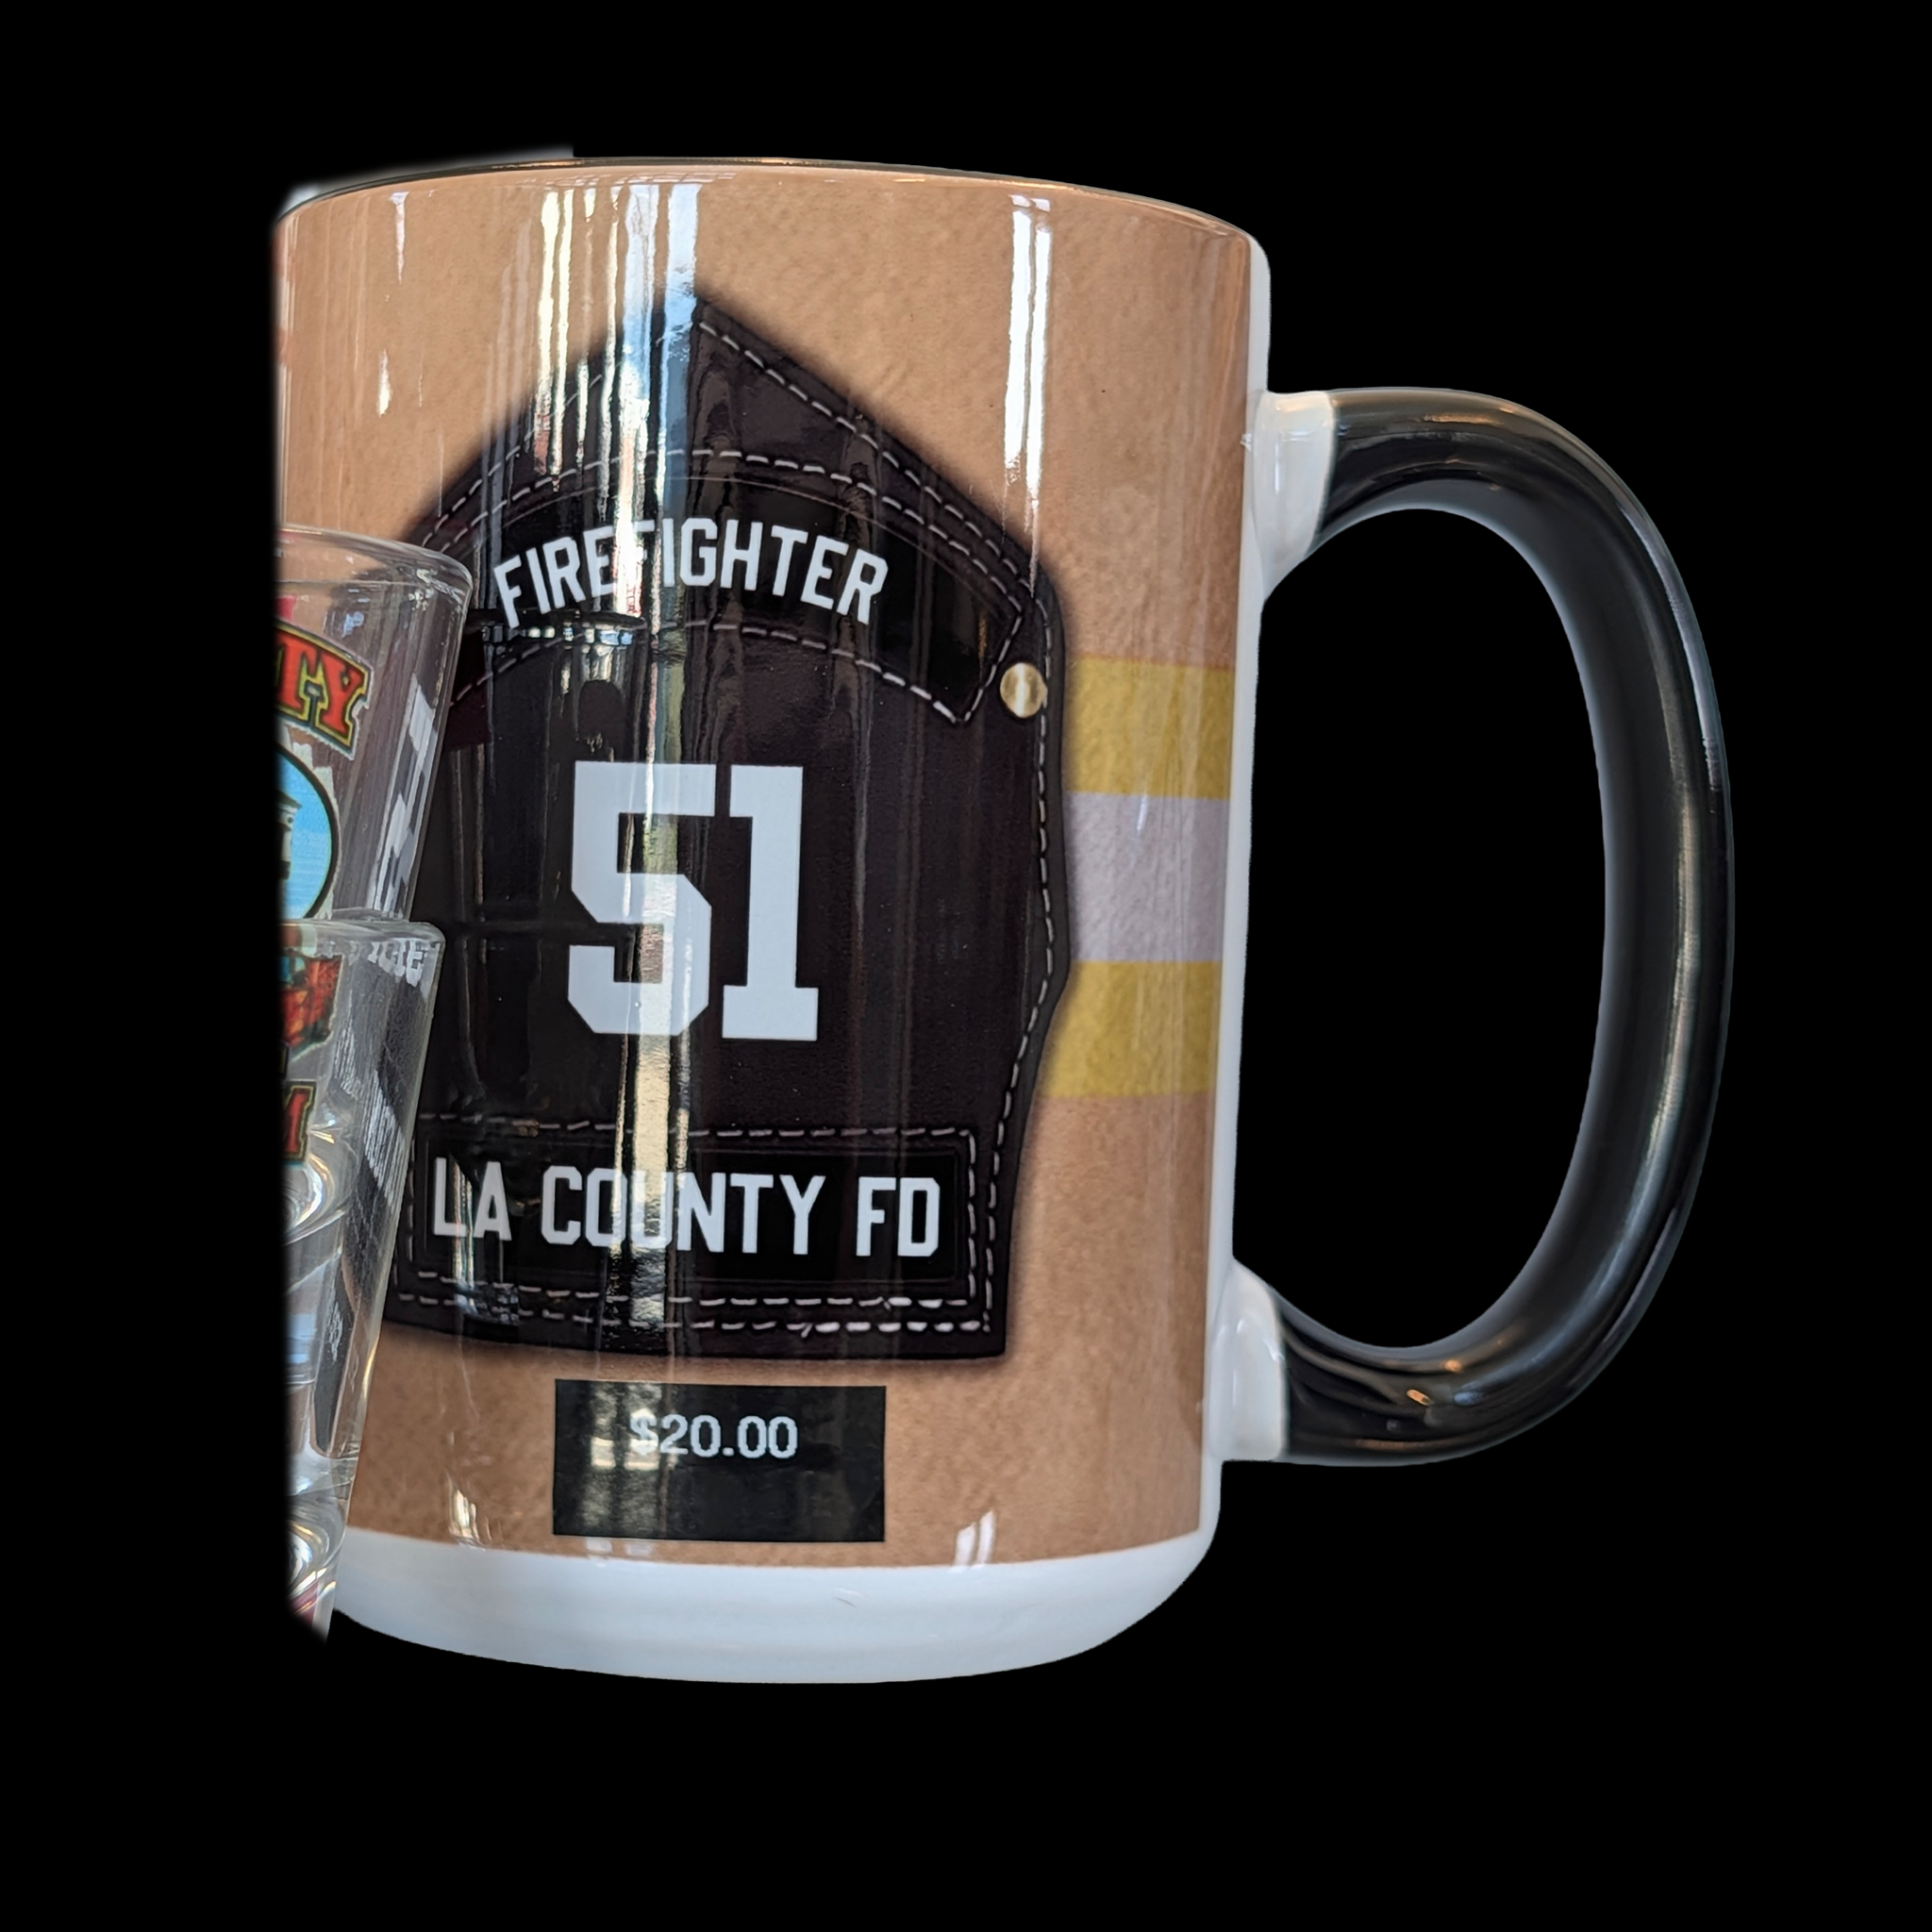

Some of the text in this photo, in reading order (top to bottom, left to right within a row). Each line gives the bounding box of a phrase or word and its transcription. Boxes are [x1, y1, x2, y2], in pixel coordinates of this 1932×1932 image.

[492, 516, 890, 629] FIREFIGHTER
[567, 759, 820, 1042] 51
[432, 1157, 941, 1257] LA COUNTY FD
[629, 1411, 798, 1459] $20.00
